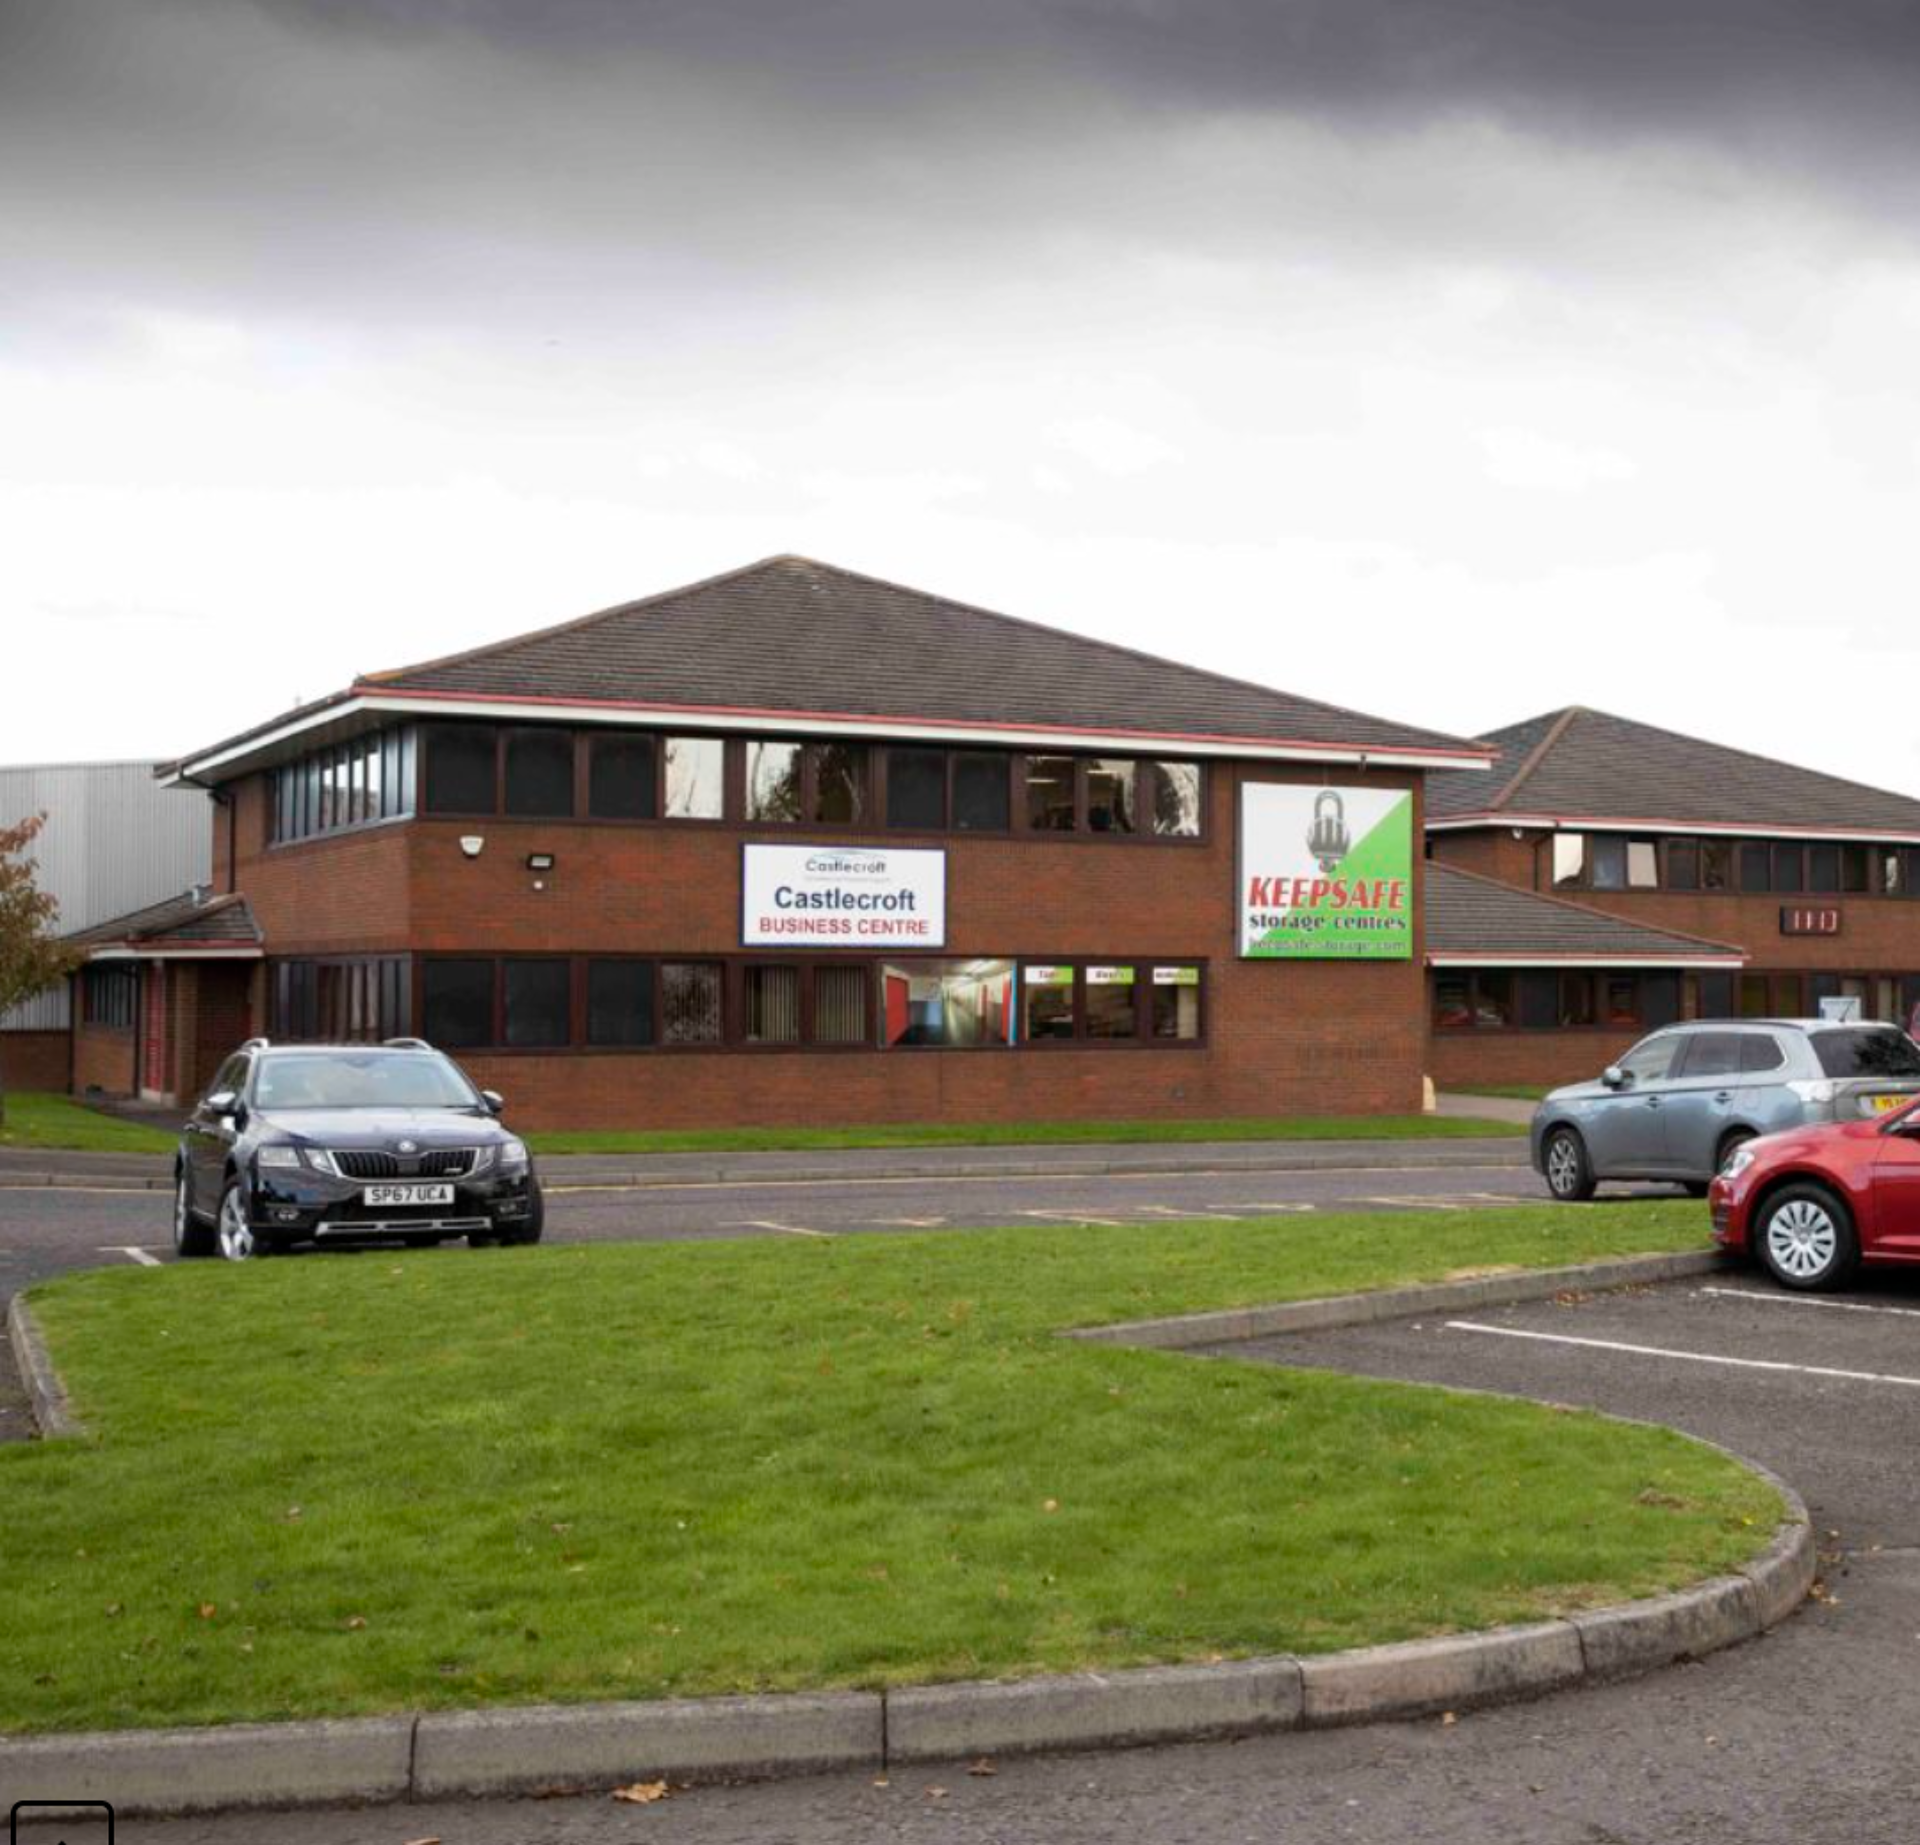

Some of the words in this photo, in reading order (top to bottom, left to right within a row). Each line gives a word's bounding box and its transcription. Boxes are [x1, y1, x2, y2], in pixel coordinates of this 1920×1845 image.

[805, 857, 886, 873] Castlecroft
[774, 886, 915, 911] Castlecroft
[1248, 877, 1406, 909] KEEPSAFE
[759, 916, 851, 934] BUSINESS
[858, 918, 929, 935] CENTRE
[1250, 913, 1324, 932] storage
[1334, 915, 1406, 930] centres
[371, 1188, 412, 1201] SP67
[417, 1186, 447, 1200] UCA
